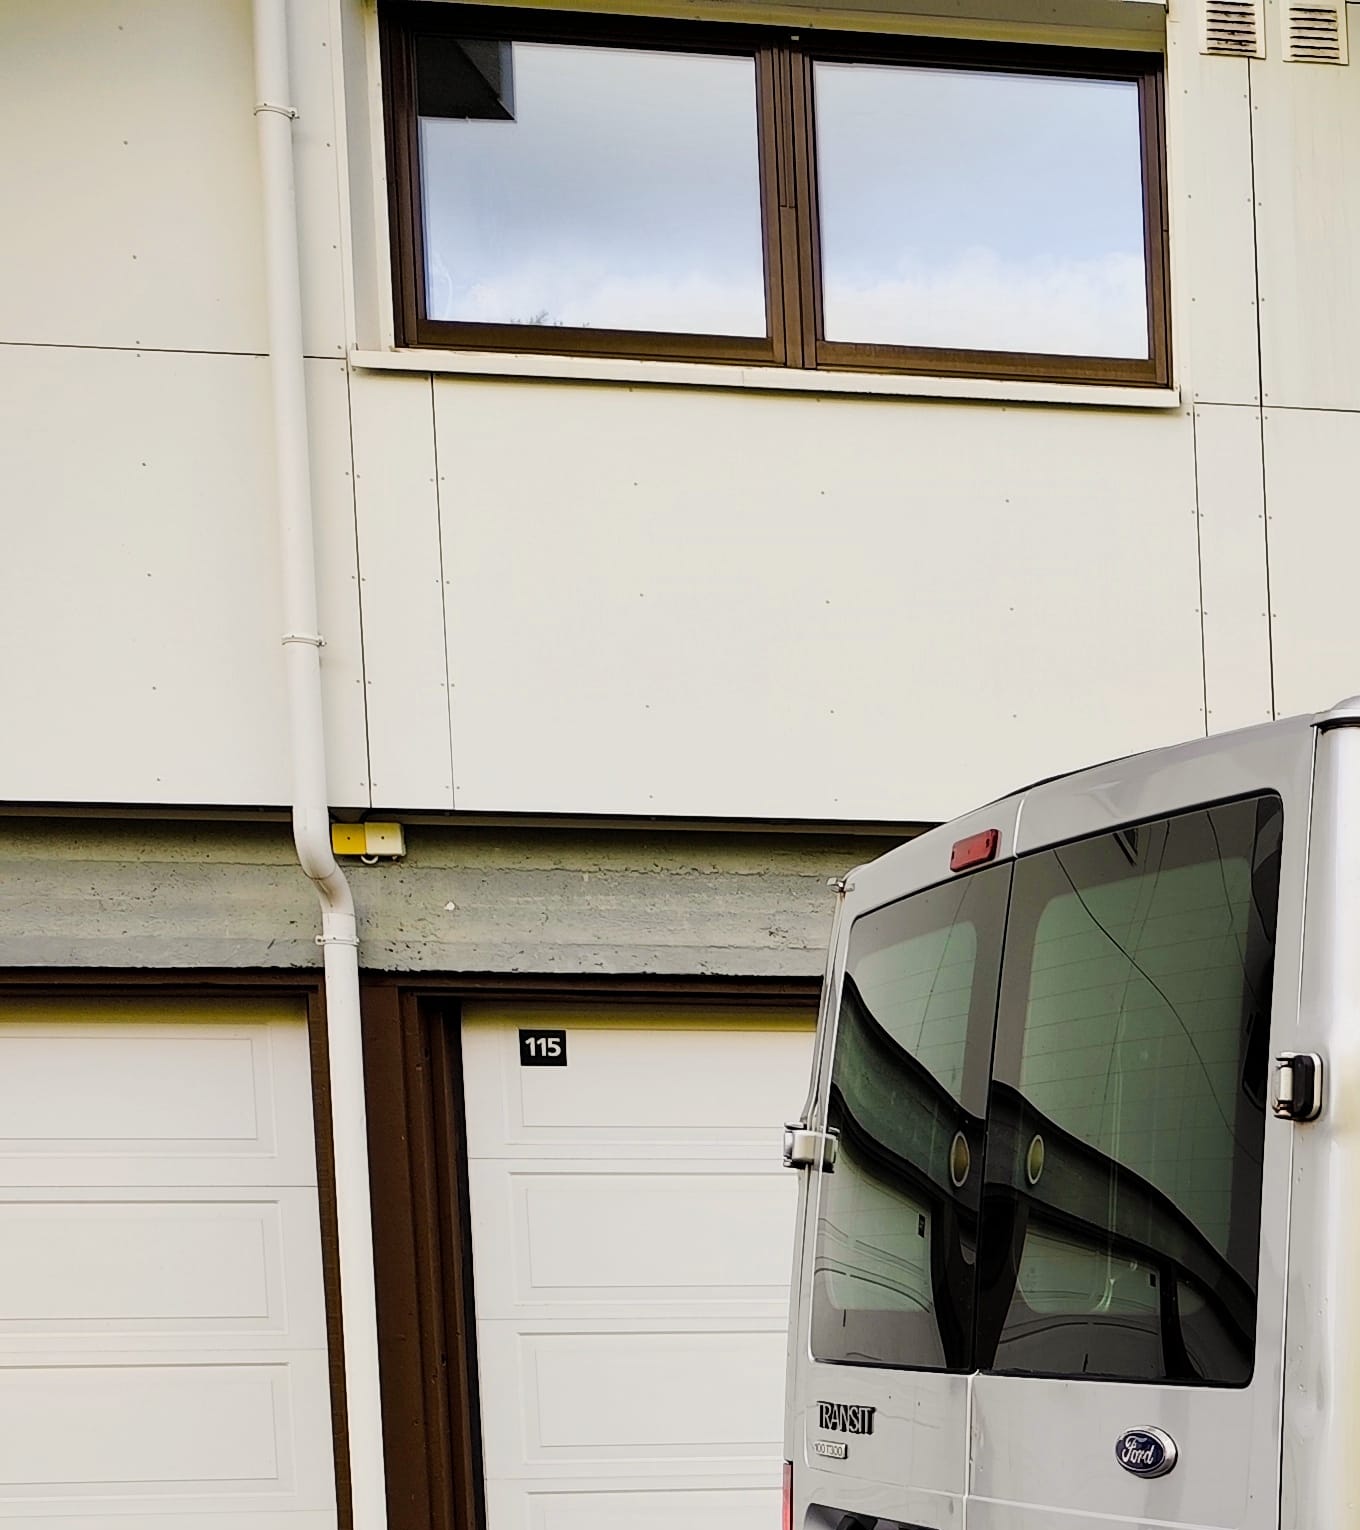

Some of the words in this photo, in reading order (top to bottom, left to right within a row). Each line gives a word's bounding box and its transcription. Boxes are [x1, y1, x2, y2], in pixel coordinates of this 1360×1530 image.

[525, 1037, 562, 1057] 115
[816, 1400, 876, 1435] TRANSIT
[1121, 1435, 1155, 1465] Ford
